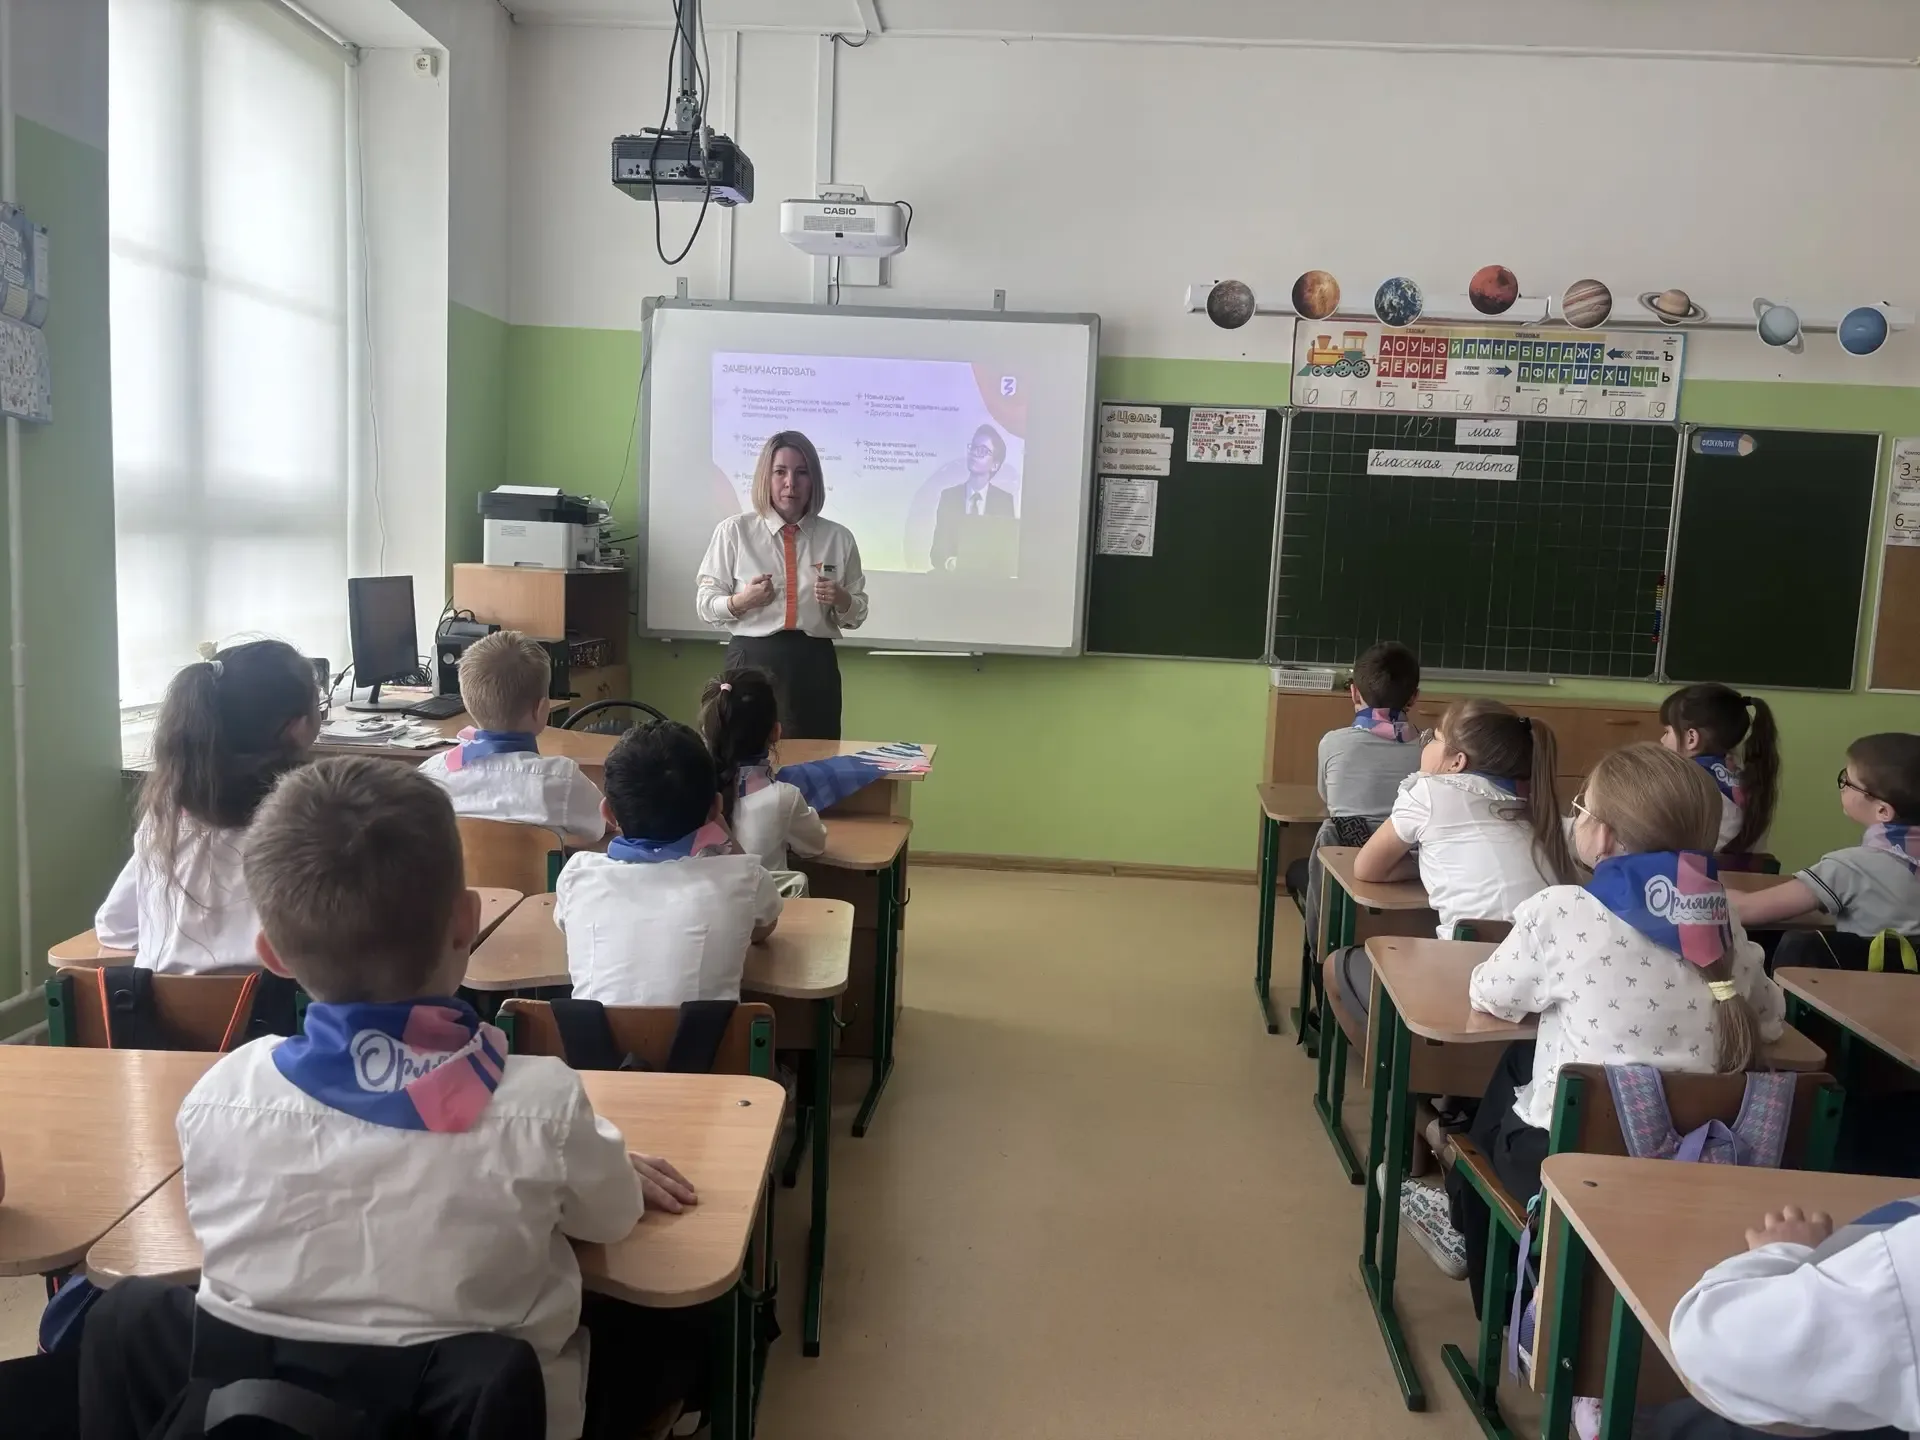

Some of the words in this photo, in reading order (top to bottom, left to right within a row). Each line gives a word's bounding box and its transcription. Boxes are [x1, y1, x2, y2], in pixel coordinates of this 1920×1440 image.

[823, 206, 857, 216] CASIO
[1662, 350, 1675, 362] Ъ
[722, 364, 753, 374] ЗАЧЕМ
[754, 366, 817, 377] УЧАСТВОВАТЬ
[1307, 388, 1318, 405] 0
[1347, 390, 1358, 406] 1
[1384, 391, 1396, 408] 2
[1422, 393, 1433, 409] 3
[1462, 395, 1472, 410] 4
[1500, 396, 1510, 412] 5
[1536, 398, 1548, 414] 6
[1576, 399, 1587, 415] 7
[1614, 401, 1626, 416] 8
[1654, 402, 1666, 418] 9
[1117, 410, 1157, 424] Цель:
[1468, 427, 1503, 438] мая
[1370, 450, 1442, 468] Классная
[1451, 454, 1516, 477] работа
[1895, 513, 1904, 527] 6
